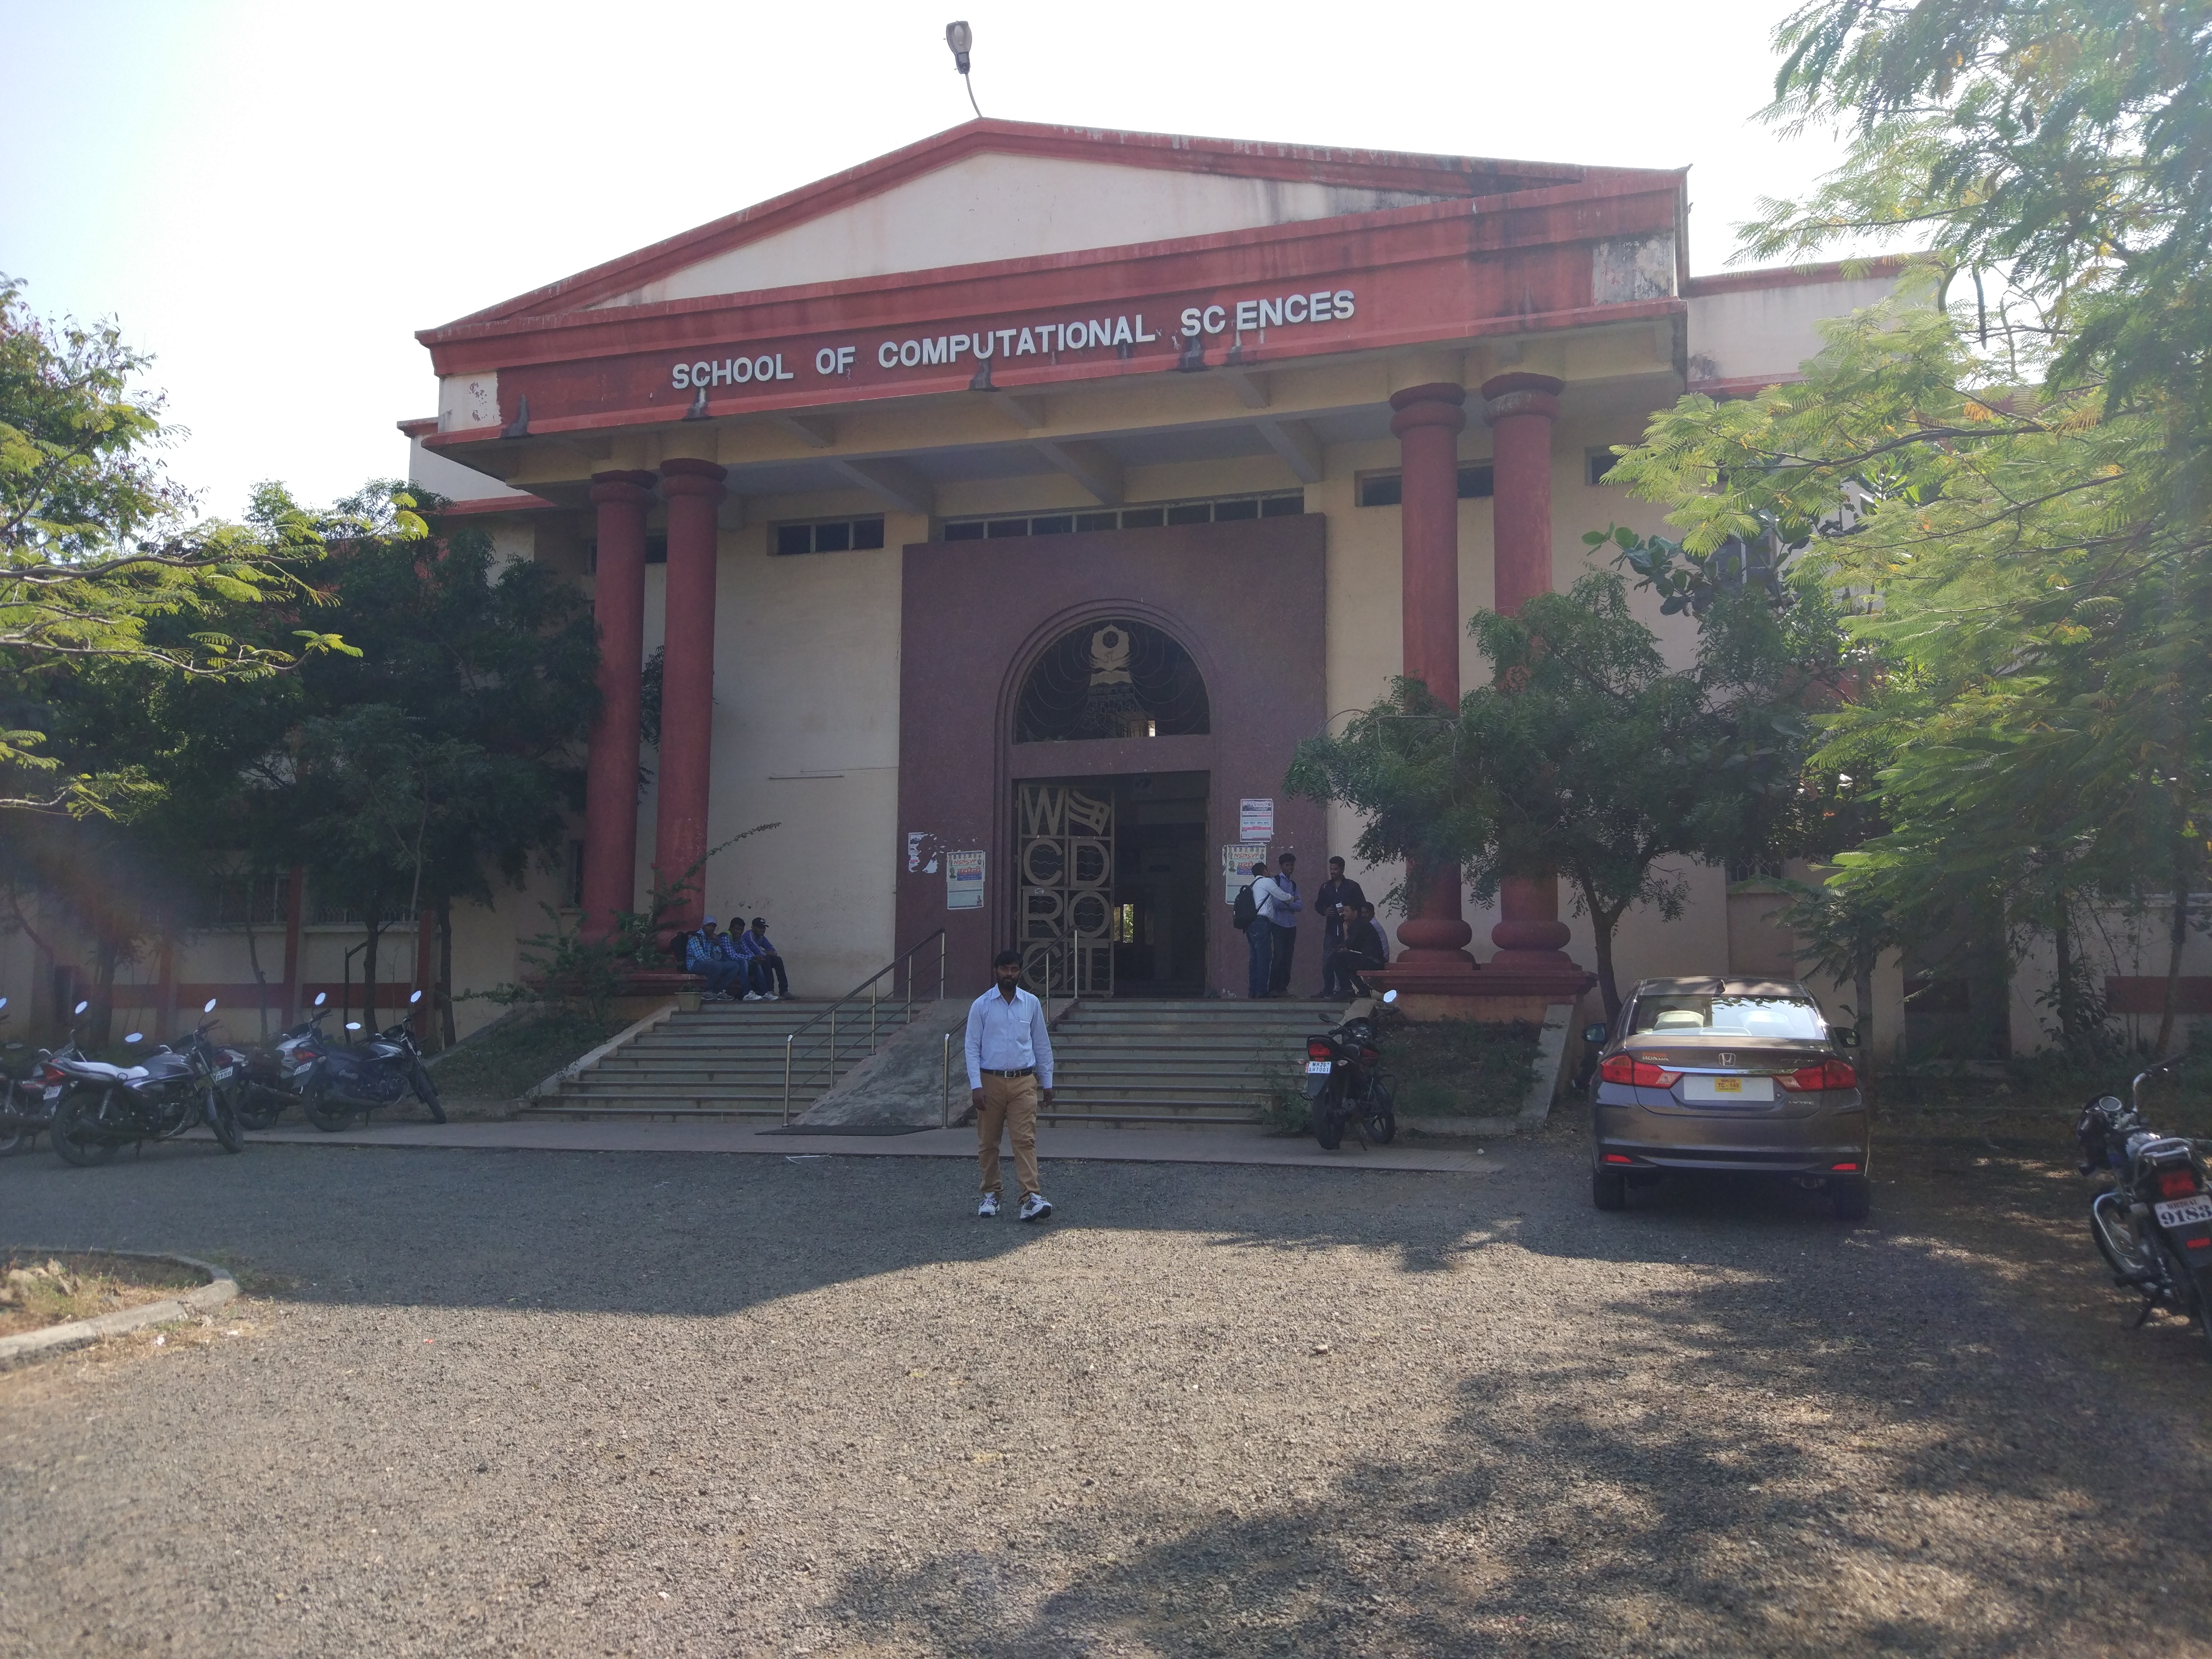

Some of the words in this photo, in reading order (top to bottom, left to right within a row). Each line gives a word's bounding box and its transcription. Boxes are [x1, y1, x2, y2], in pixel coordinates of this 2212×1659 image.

[672, 353, 793, 389] SCHOOL
[816, 346, 856, 374] OF
[878, 313, 1156, 368] COMPUTATIONAL
